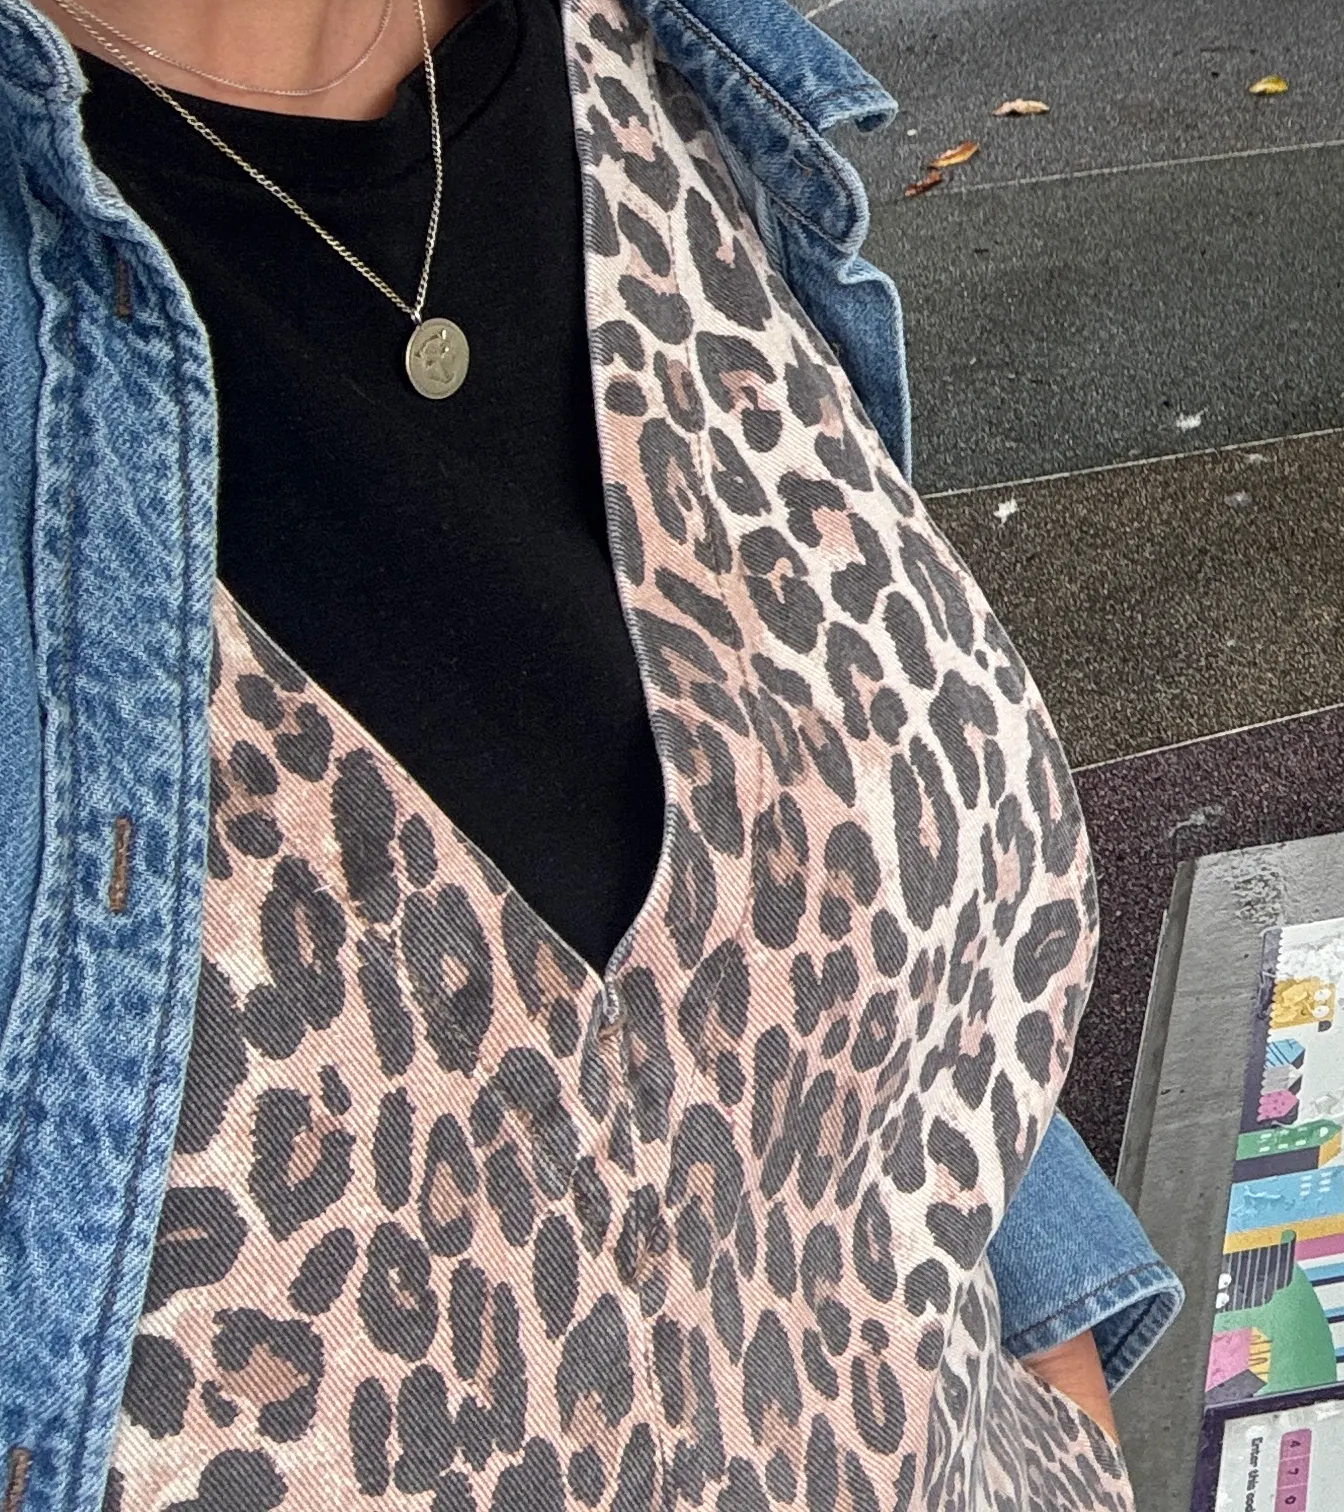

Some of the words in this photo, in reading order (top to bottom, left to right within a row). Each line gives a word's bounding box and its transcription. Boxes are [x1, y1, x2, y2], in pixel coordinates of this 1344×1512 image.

[1250, 1437, 1263, 1468] Enter
[1246, 1469, 1259, 1491] this
[1244, 1492, 1256, 1512] cod
